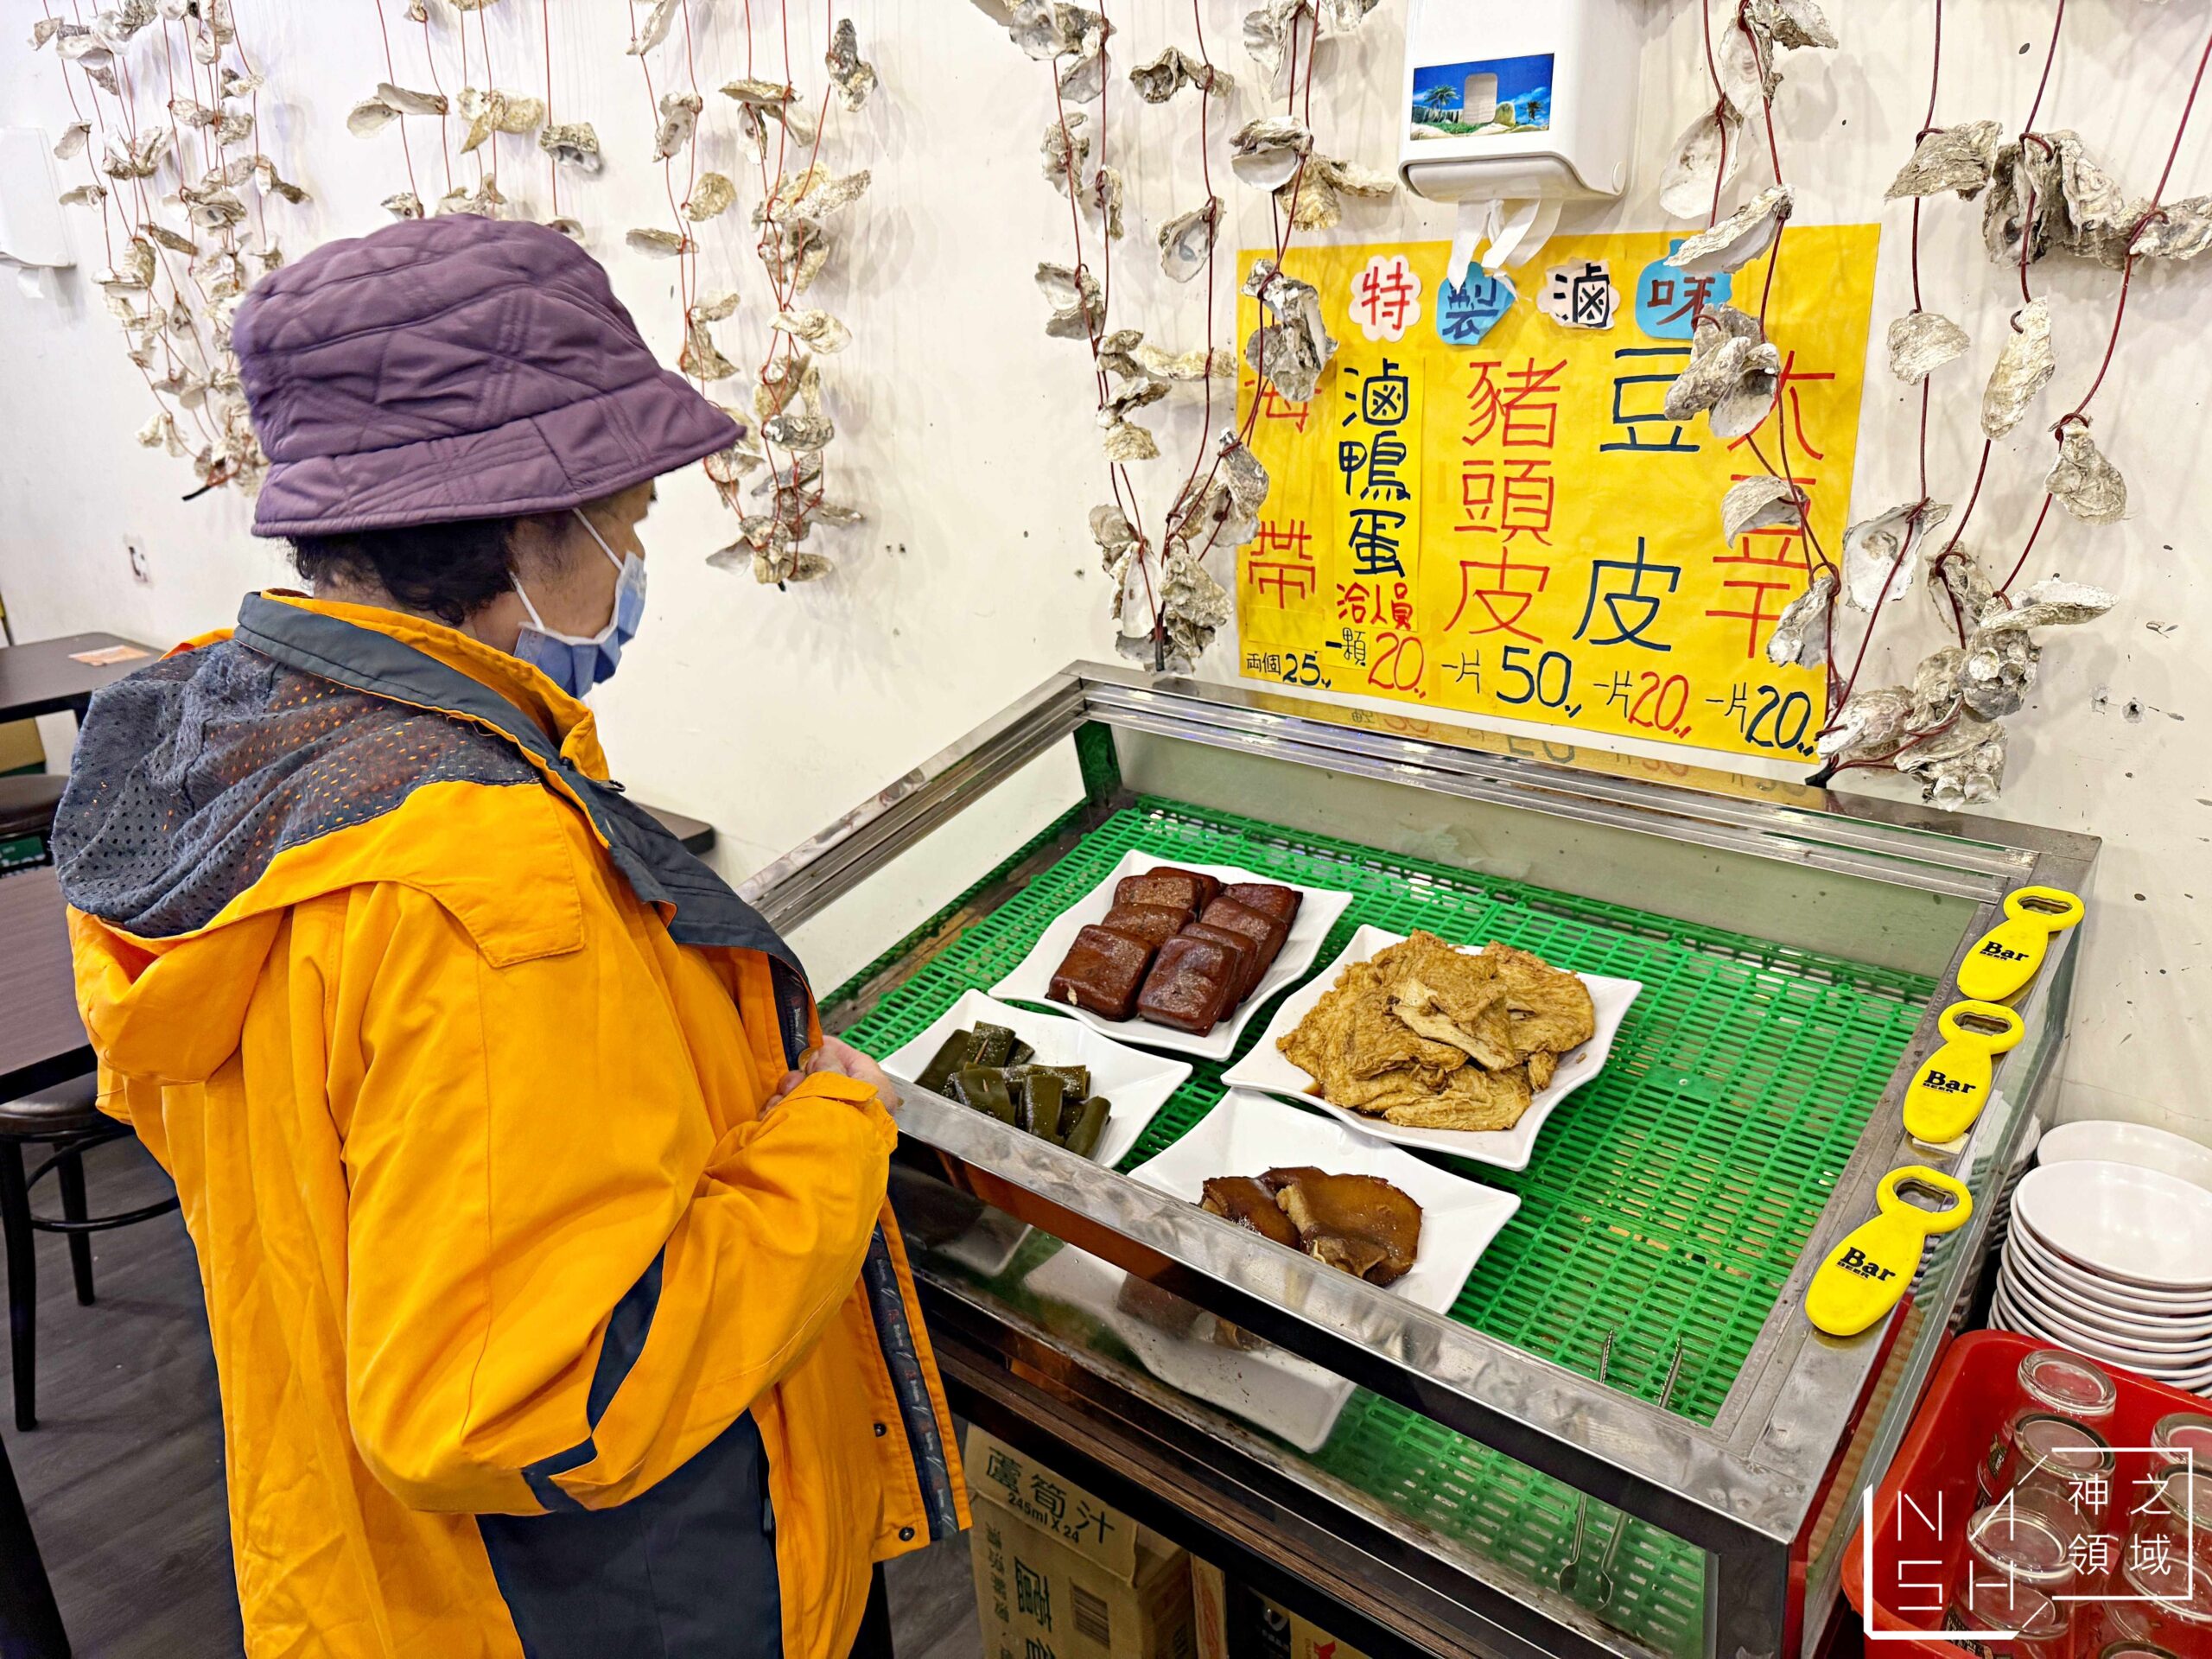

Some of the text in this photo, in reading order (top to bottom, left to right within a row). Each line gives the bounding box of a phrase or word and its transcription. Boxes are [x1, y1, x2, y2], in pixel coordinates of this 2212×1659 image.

[1361, 261, 1714, 340] 特製滷味
[1339, 358, 1410, 578] 滷鴨蛋
[1444, 357, 1567, 643] 豬頭皮
[1572, 347, 1700, 652] 豆皮
[1982, 941, 2030, 961] Bar
[1923, 1082, 1954, 1094] BEER
[1924, 1070, 1976, 1093] Bar
[1836, 1261, 1869, 1279] BEER
[1840, 1247, 1896, 1281] Bar
[987, 1446, 1115, 1543] 蘆筍汁
[1008, 1492, 1048, 1525] 245ml
[1064, 1526, 1080, 1544] 24
